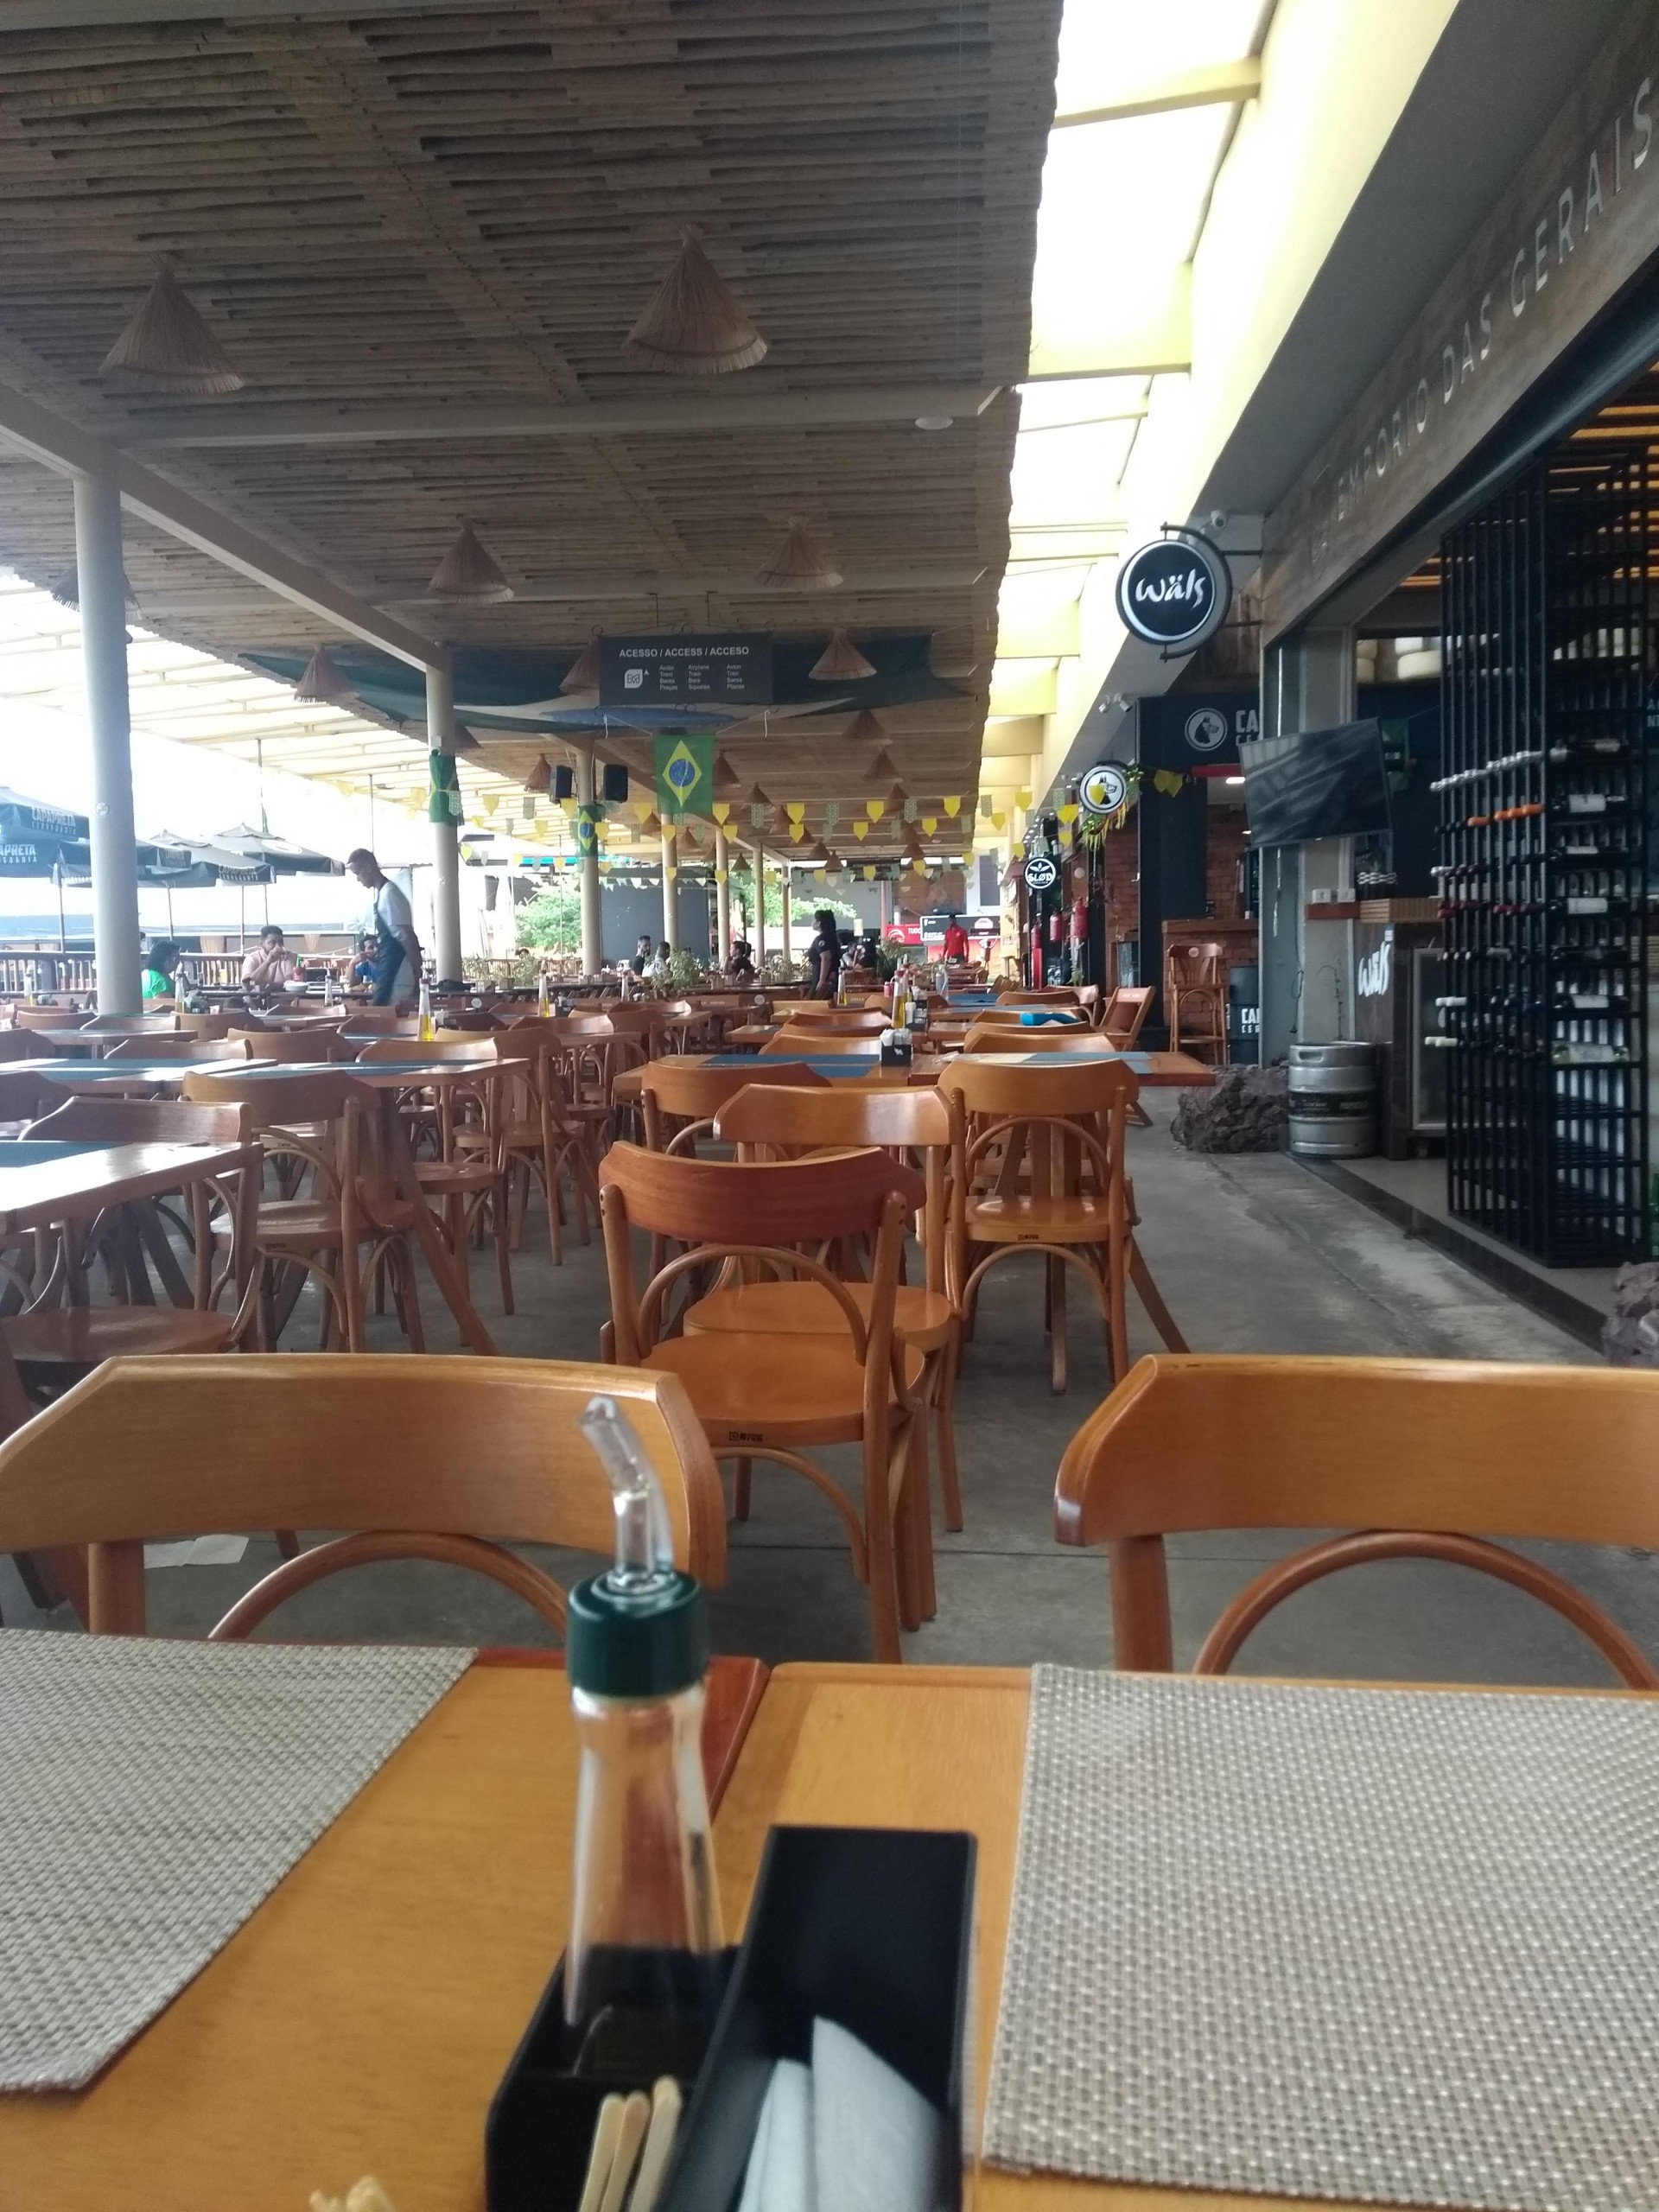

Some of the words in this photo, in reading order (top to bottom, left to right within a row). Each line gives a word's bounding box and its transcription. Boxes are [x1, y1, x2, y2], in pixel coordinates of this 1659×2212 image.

[1442, 294, 1492, 404] DAS
[1510, 77, 1653, 318] GERAIS
[1135, 568, 1206, 611] wäls
[619, 649, 658, 658] ACESSO
[664, 648, 702, 657] ACCESS
[709, 646, 749, 656] ACCESO
